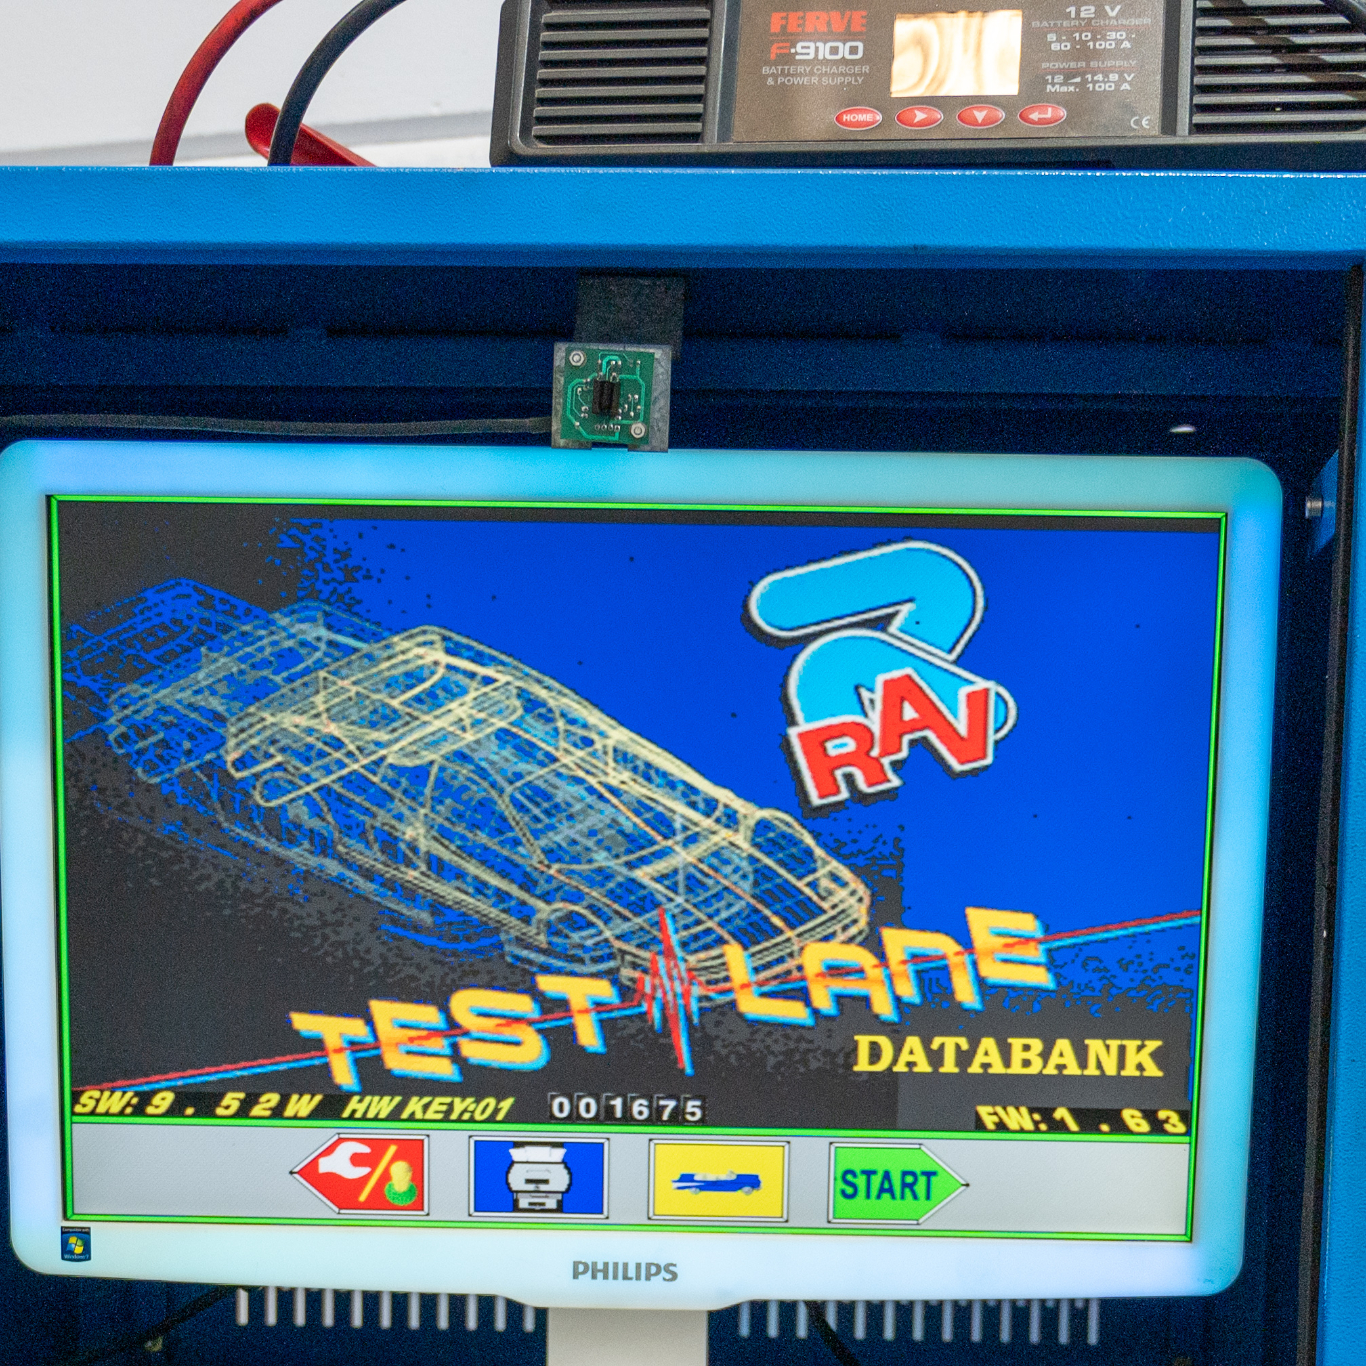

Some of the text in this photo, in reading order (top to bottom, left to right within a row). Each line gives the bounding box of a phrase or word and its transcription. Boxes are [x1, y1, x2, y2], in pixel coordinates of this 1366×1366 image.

[1066, 5, 1122, 18] 12 V
[770, 10, 867, 33] FERVE
[1031, 17, 1152, 28] BATTERY CHARGER
[1073, 32, 1092, 40] 10
[1106, 31, 1127, 39] 30
[1051, 42, 1071, 51] 60
[1087, 41, 1116, 50] 100
[1120, 40, 1132, 49] A
[1089, 60, 1137, 68] SUPPLY
[762, 65, 870, 75] BATTERY CHARGER
[766, 76, 864, 86] & POWER SUPPLY
[1045, 75, 1064, 83] 12
[1124, 73, 1135, 81] V
[1046, 82, 1132, 92] Max. 100 A
[843, 113, 874, 122] HOME
[791, 667, 994, 804] RAV
[289, 974, 621, 1094] TEST
[852, 1034, 1165, 1078] DATABANK
[342, 1095, 404, 1120] HW
[402, 1096, 516, 1121] KEY:01
[839, 1169, 939, 1202] START
[572, 1260, 679, 1284] PHILIPS
